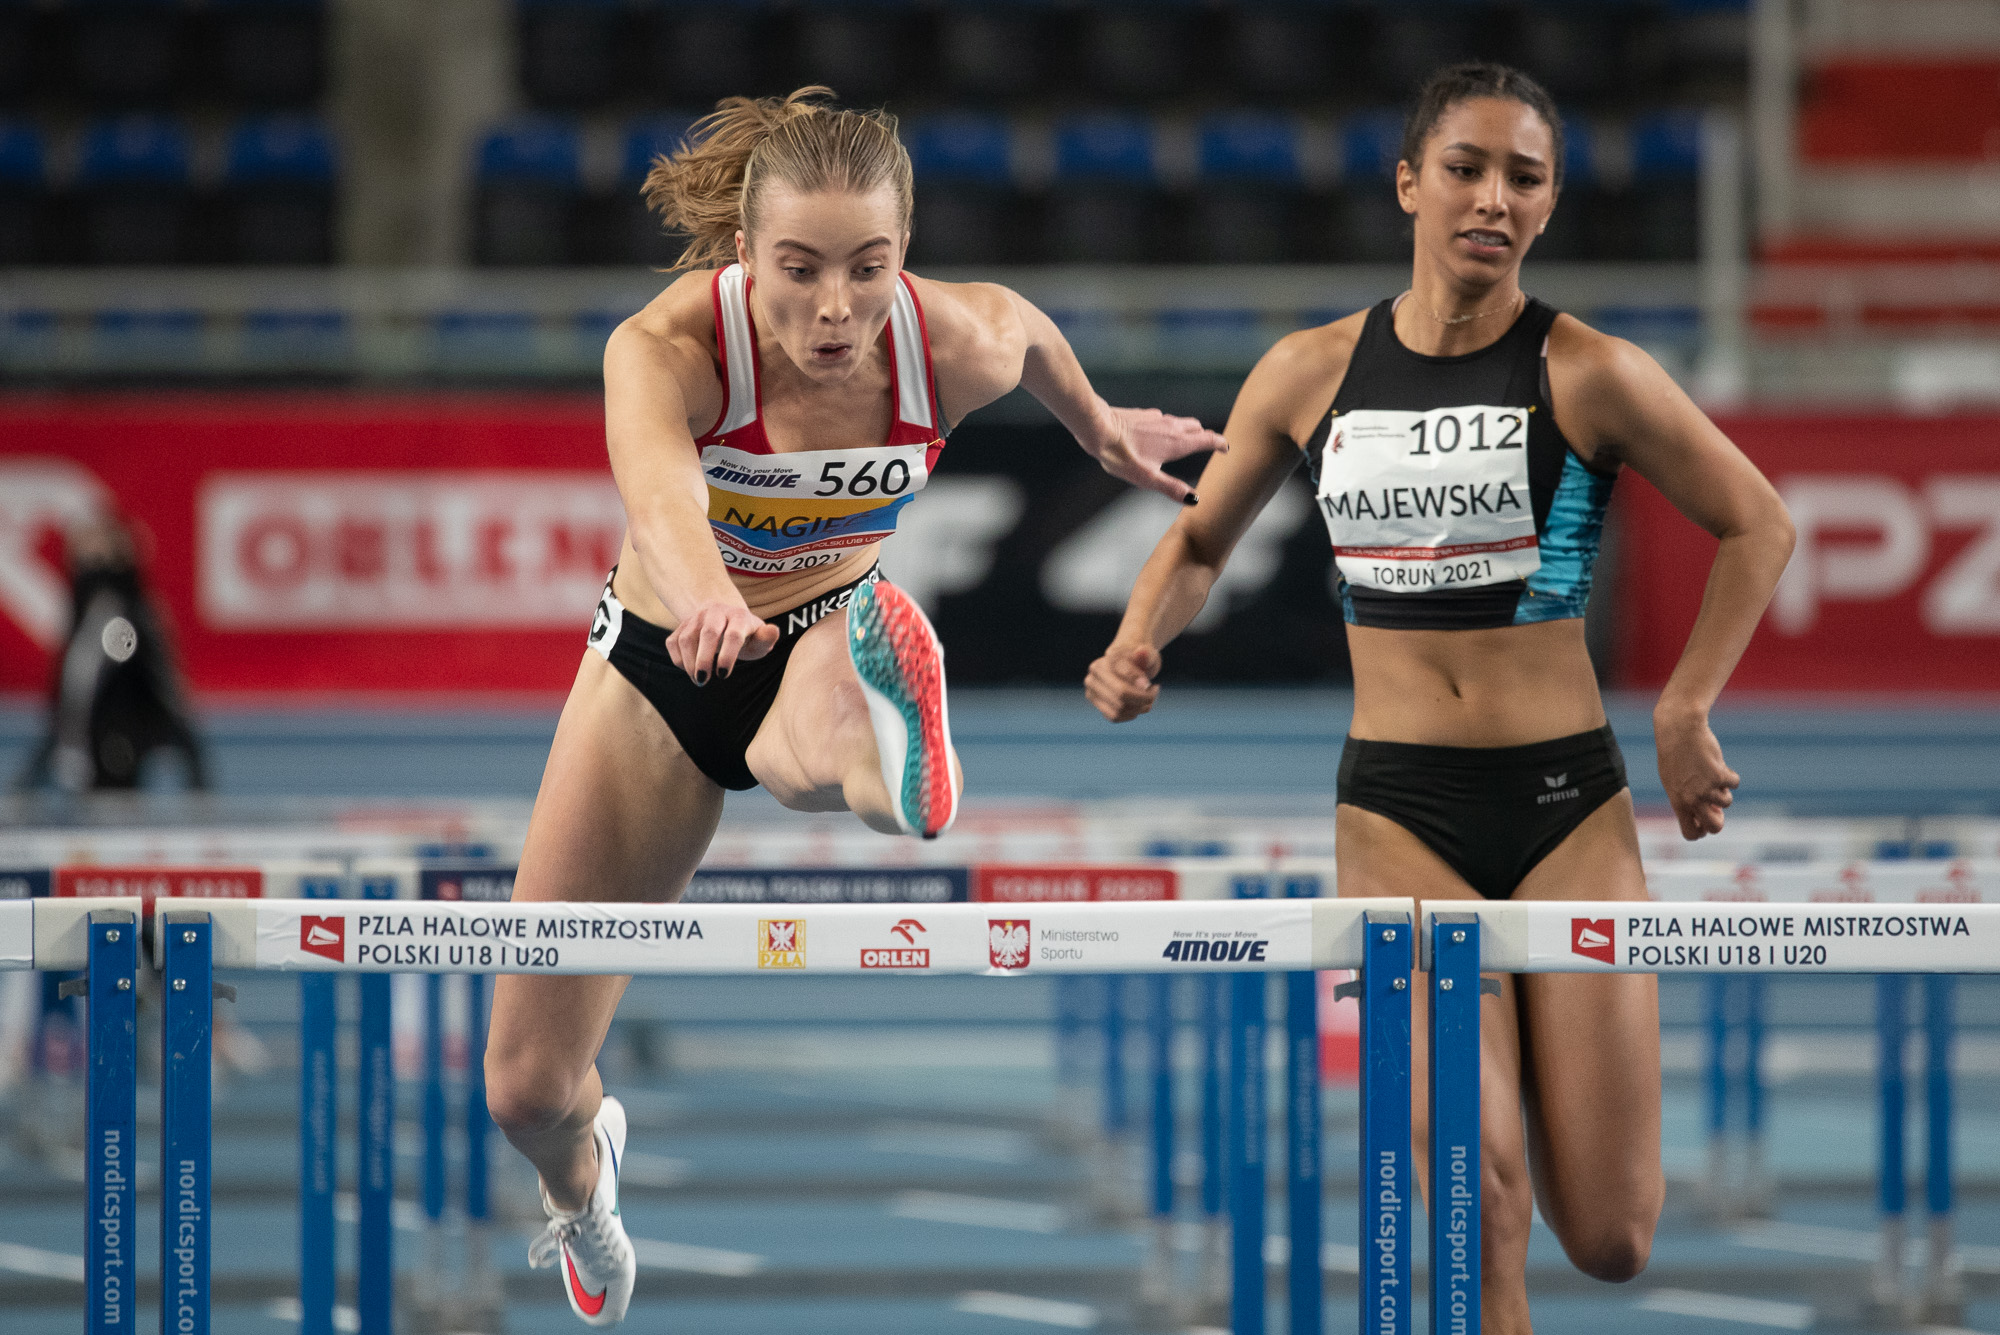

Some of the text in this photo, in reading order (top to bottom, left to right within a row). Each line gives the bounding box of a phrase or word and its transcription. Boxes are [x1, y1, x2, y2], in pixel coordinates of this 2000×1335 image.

[1409, 412, 1523, 456] 1012
[719, 459, 739, 470] Now
[705, 466, 802, 489] 4MOVE
[813, 458, 911, 496] 560
[1323, 481, 1522, 521] MAJEWSKA
[713, 531, 744, 550] ALOWE
[744, 546, 811, 558] MISTRZOSTWA
[812, 540, 845, 549] POLSKI
[718, 546, 842, 571] ORUŃ 2021
[1372, 559, 1492, 586] TORUŃ 2021
[787, 588, 853, 636] NIKE
[1536, 787, 1580, 805] erima
[358, 916, 704, 940] PZLA HALOWE MISTRZOSTWA
[1041, 929, 1119, 942] Ministerstwo
[1172, 931, 1193, 939] Now
[1211, 932, 1232, 940] your
[1628, 916, 1971, 937] PZLA HALOWE MISTRZOSTWA
[358, 944, 559, 967] POLSKI U18 I U20
[760, 952, 803, 967] PZLA
[863, 950, 926, 967] ORLEN
[1040, 947, 1083, 961] Sportu
[1162, 940, 1269, 962] 4MOVE
[1628, 945, 1827, 966] POLSKI U18 I U20
[99, 1129, 127, 1325] nordicsport.com
[173, 1159, 201, 1335] nordicsport.co
